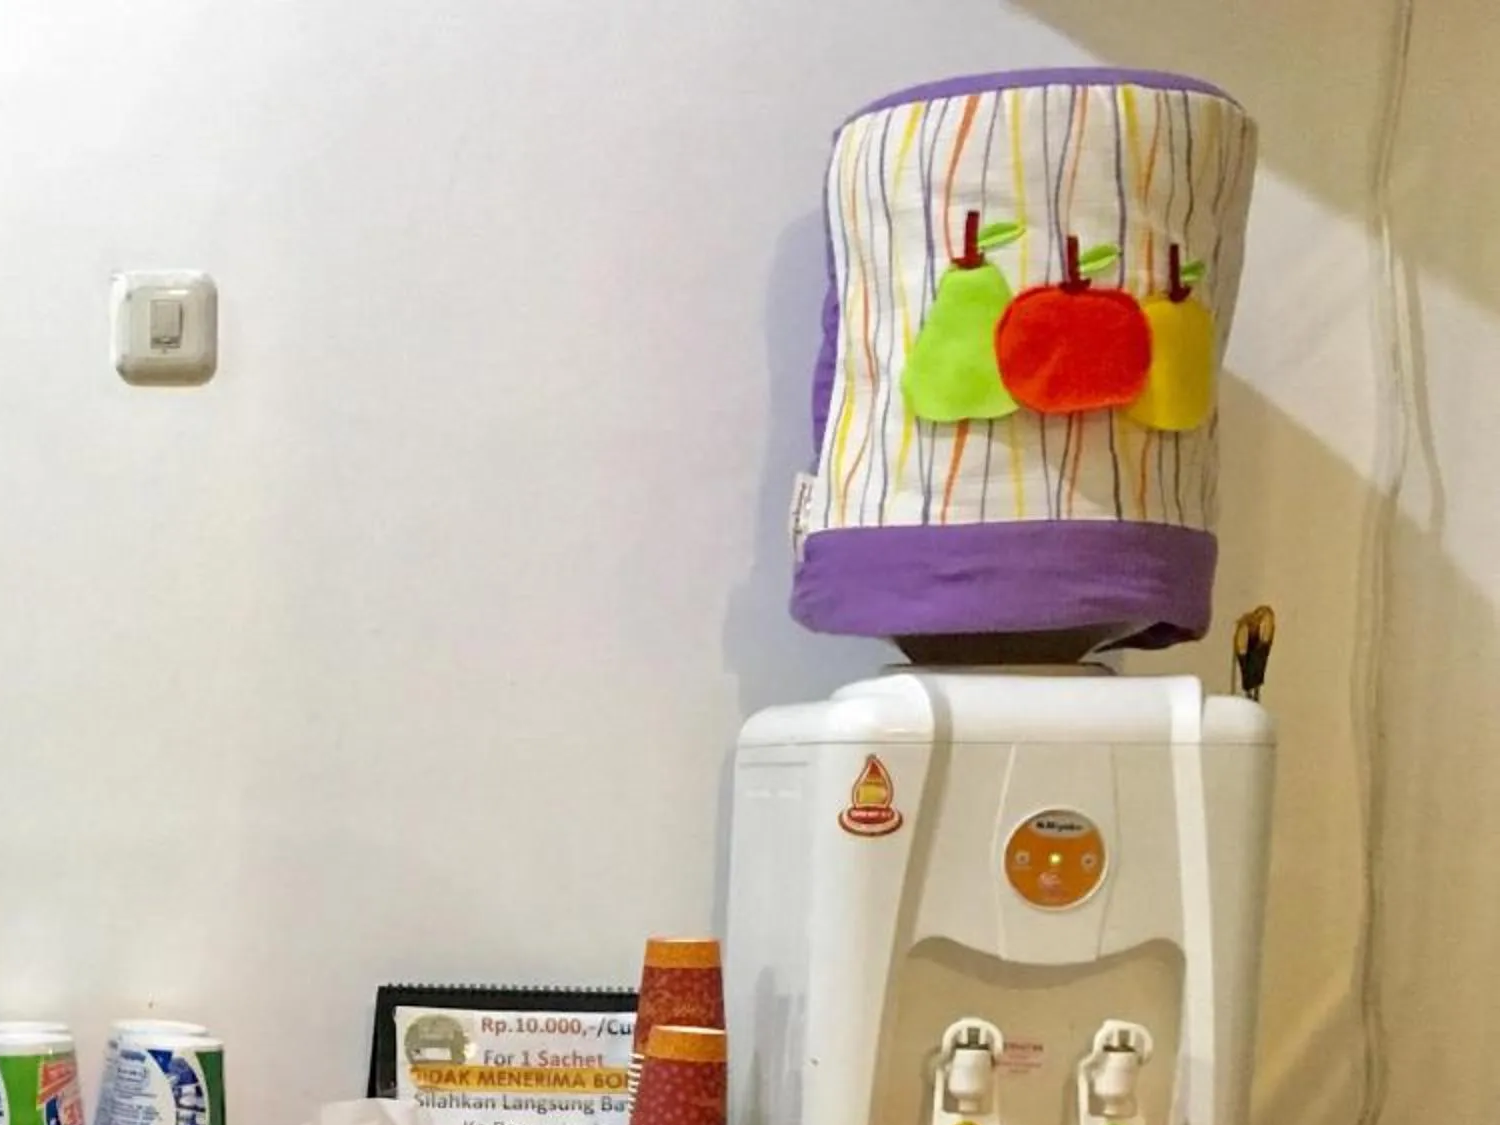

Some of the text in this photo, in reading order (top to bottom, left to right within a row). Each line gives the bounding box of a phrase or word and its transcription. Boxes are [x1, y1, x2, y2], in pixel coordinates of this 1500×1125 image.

[481, 1016, 634, 1038] Rp.10.000,-/Cu
[483, 1049, 604, 1067] For 1 Sachet
[477, 1070, 586, 1089] MENERIMA
[415, 1092, 628, 1115] Silahkan Langsung Ba
